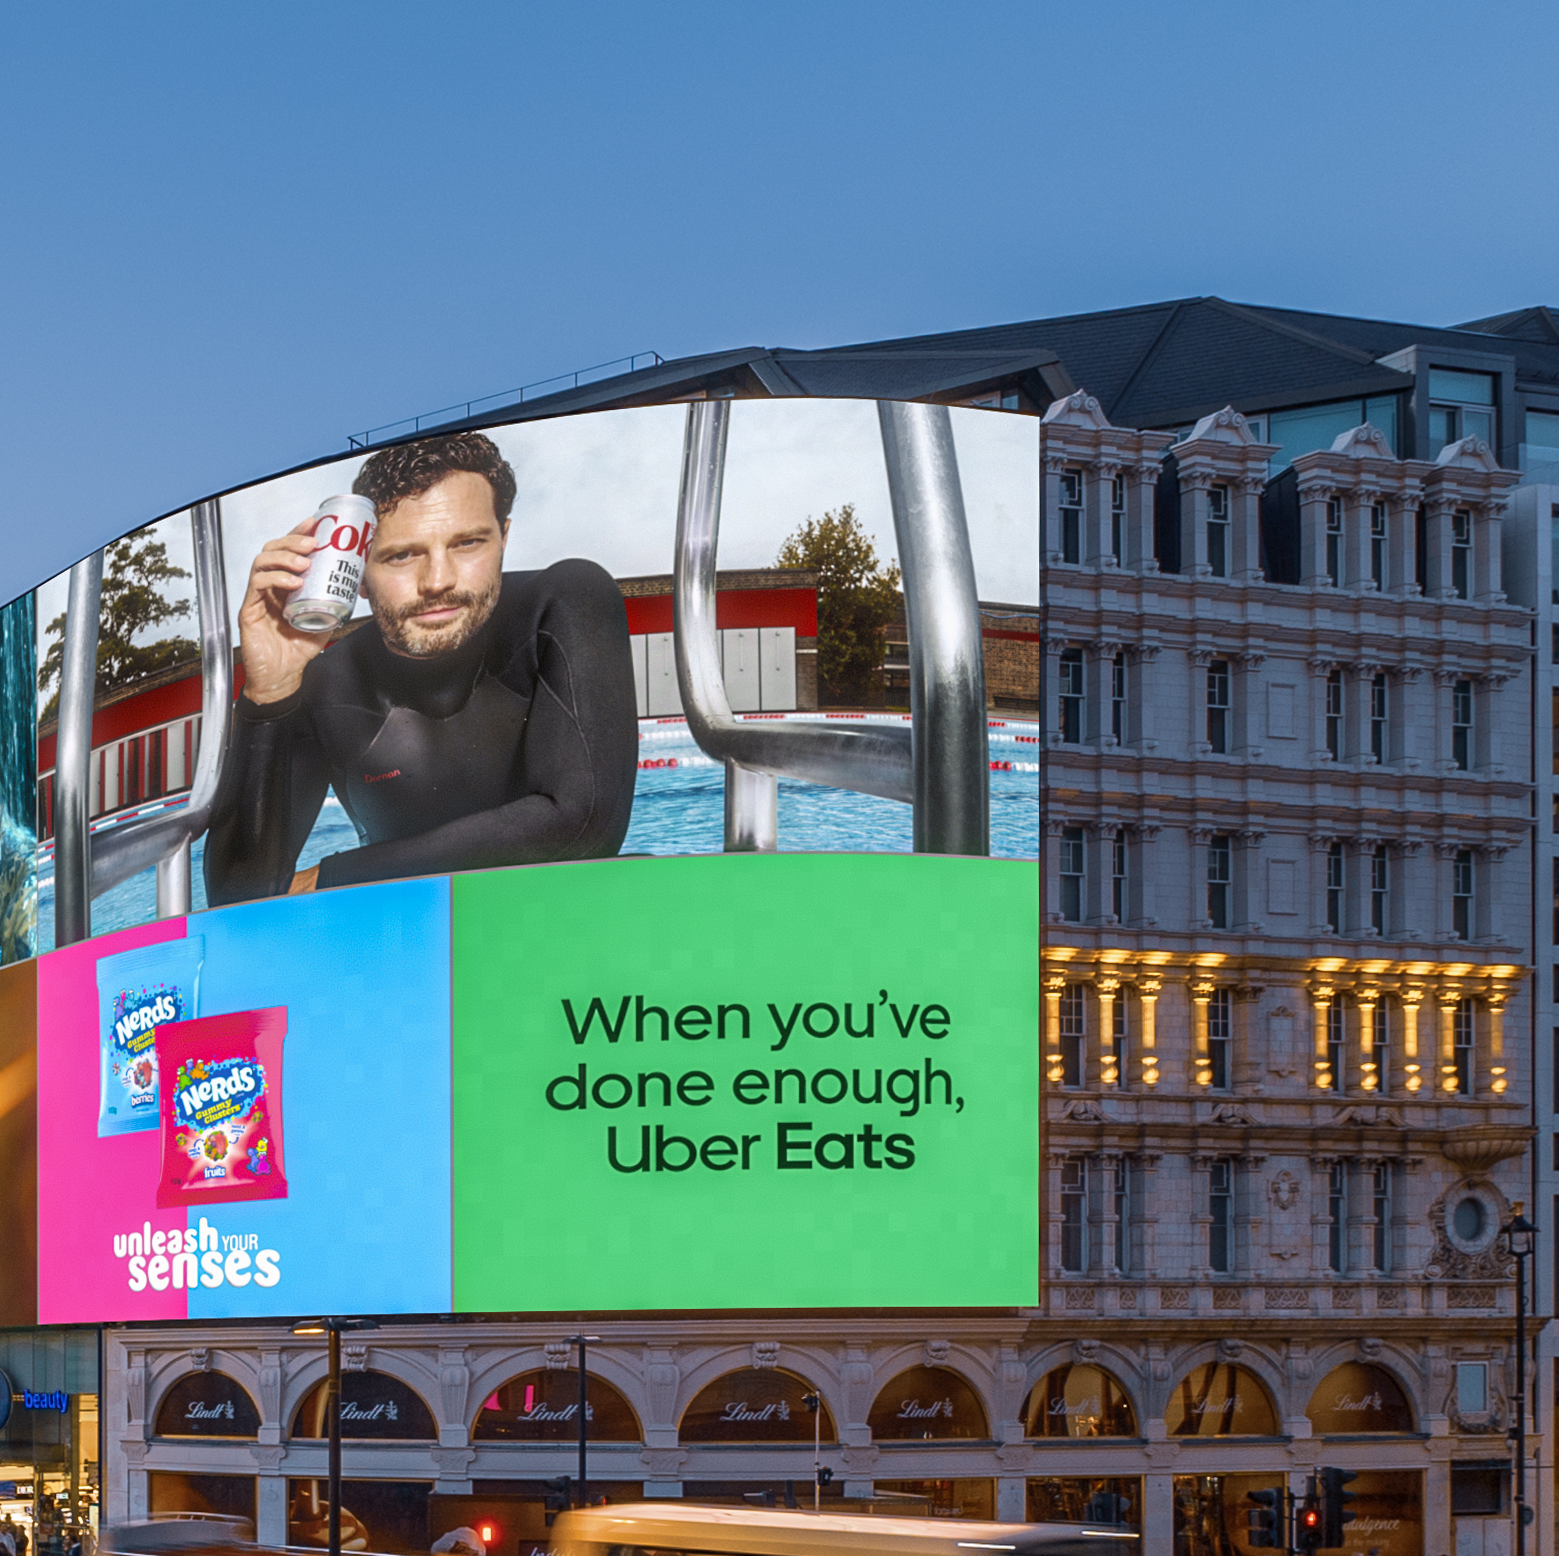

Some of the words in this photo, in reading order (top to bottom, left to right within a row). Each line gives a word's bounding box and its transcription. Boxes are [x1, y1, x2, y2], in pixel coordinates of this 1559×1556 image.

[310, 514, 374, 563] Cok
[337, 559, 360, 579] This
[328, 570, 340, 583] is
[341, 576, 358, 592] my
[561, 994, 751, 1045] When
[767, 989, 951, 1051] you've
[545, 1062, 715, 1111] done
[732, 1057, 965, 1117] enough,
[131, 1094, 154, 1106] berries
[195, 1098, 232, 1121] Gummy
[204, 1105, 241, 1125] Clusters
[607, 1124, 761, 1173] Uber
[776, 1121, 916, 1170] Eats
[204, 1166, 226, 1179] fruits
[113, 1217, 219, 1258] unleash
[222, 1234, 259, 1251] YOUR
[128, 1249, 281, 1292] senses
[24, 1390, 68, 1412] beauty
[185, 1401, 225, 1420] Lindt
[896, 1399, 943, 1418] Lindt
[1048, 1397, 1093, 1416] Lindt
[1192, 1397, 1233, 1415] Lindt
[1333, 1393, 1371, 1411] Lindt
[517, 1402, 580, 1421] Lindt
[719, 1402, 776, 1421] Lindt
[1343, 1516, 1400, 1537] dulgence
